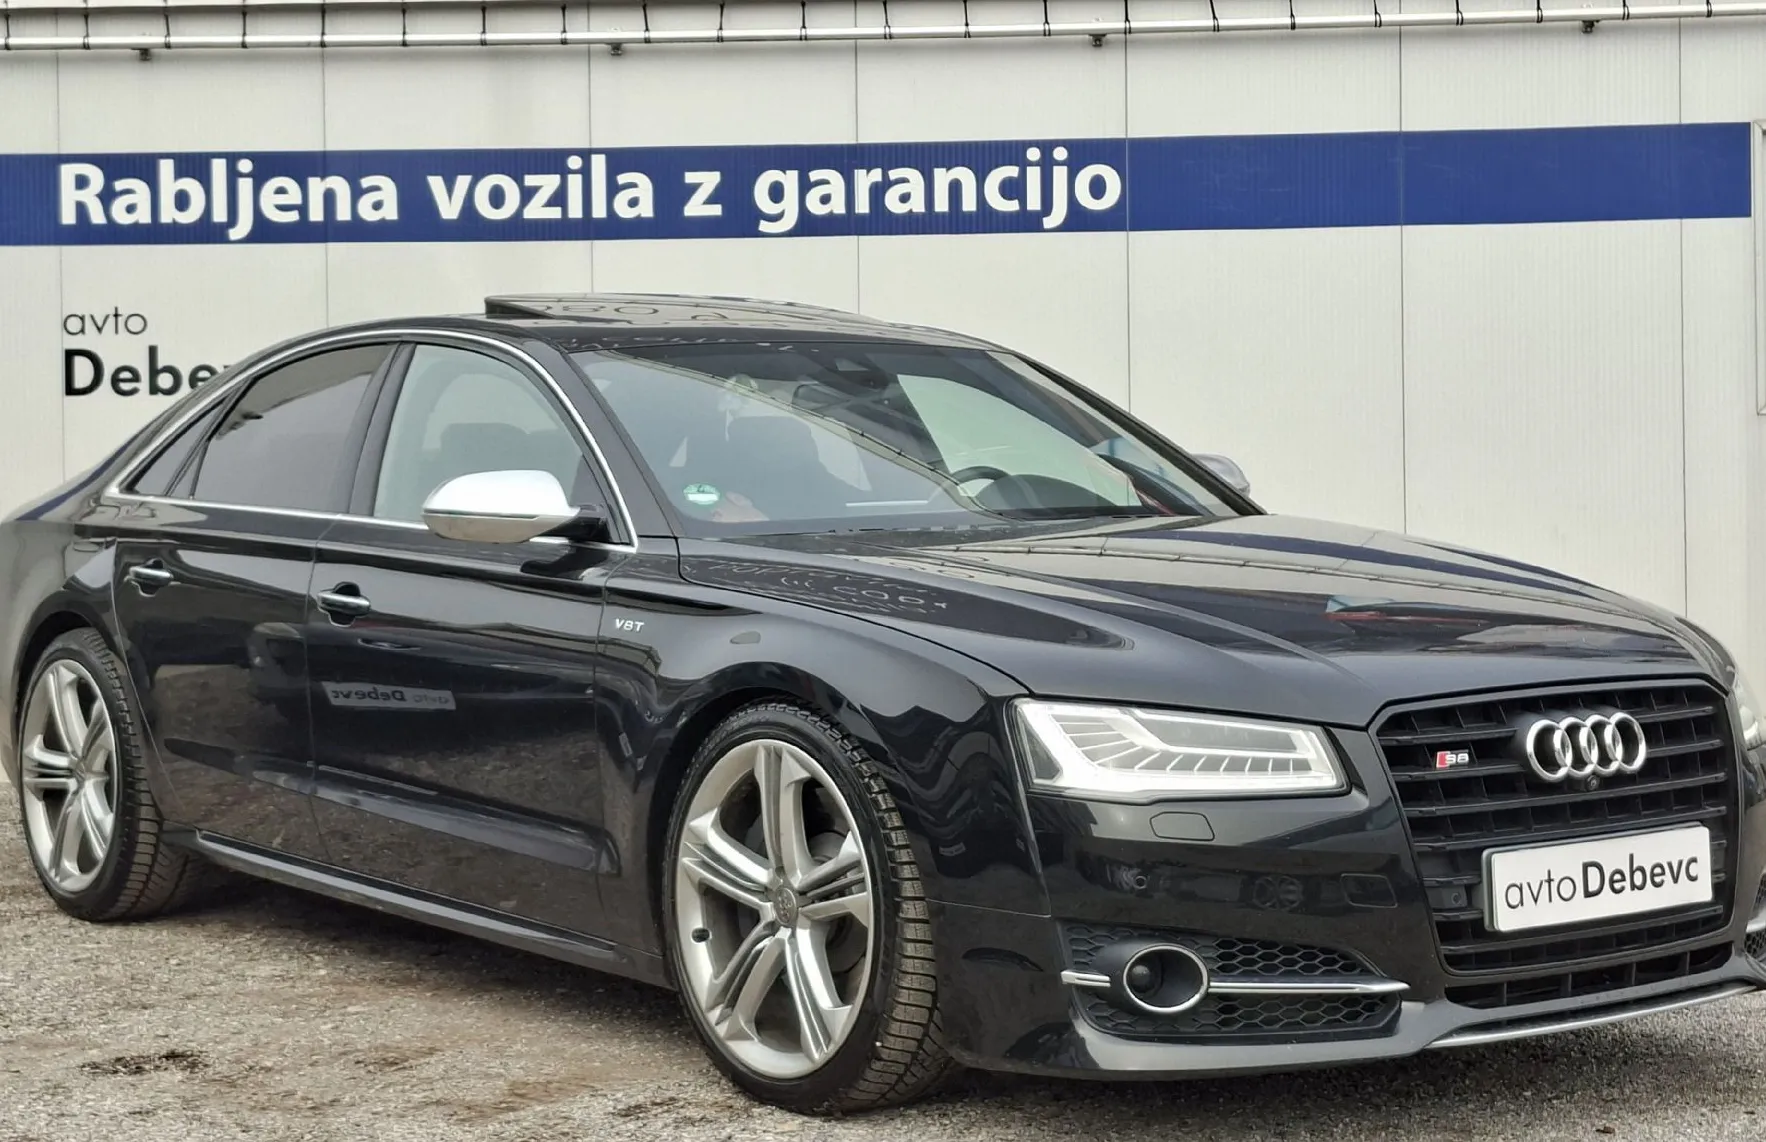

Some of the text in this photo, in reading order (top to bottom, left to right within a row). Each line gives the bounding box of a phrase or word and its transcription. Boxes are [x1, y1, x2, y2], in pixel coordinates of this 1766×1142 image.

[59, 146, 1122, 242] Rabljena vozila z garancijo
[63, 306, 148, 336] avto
[64, 344, 232, 397] Debe
[615, 618, 645, 632] V8T
